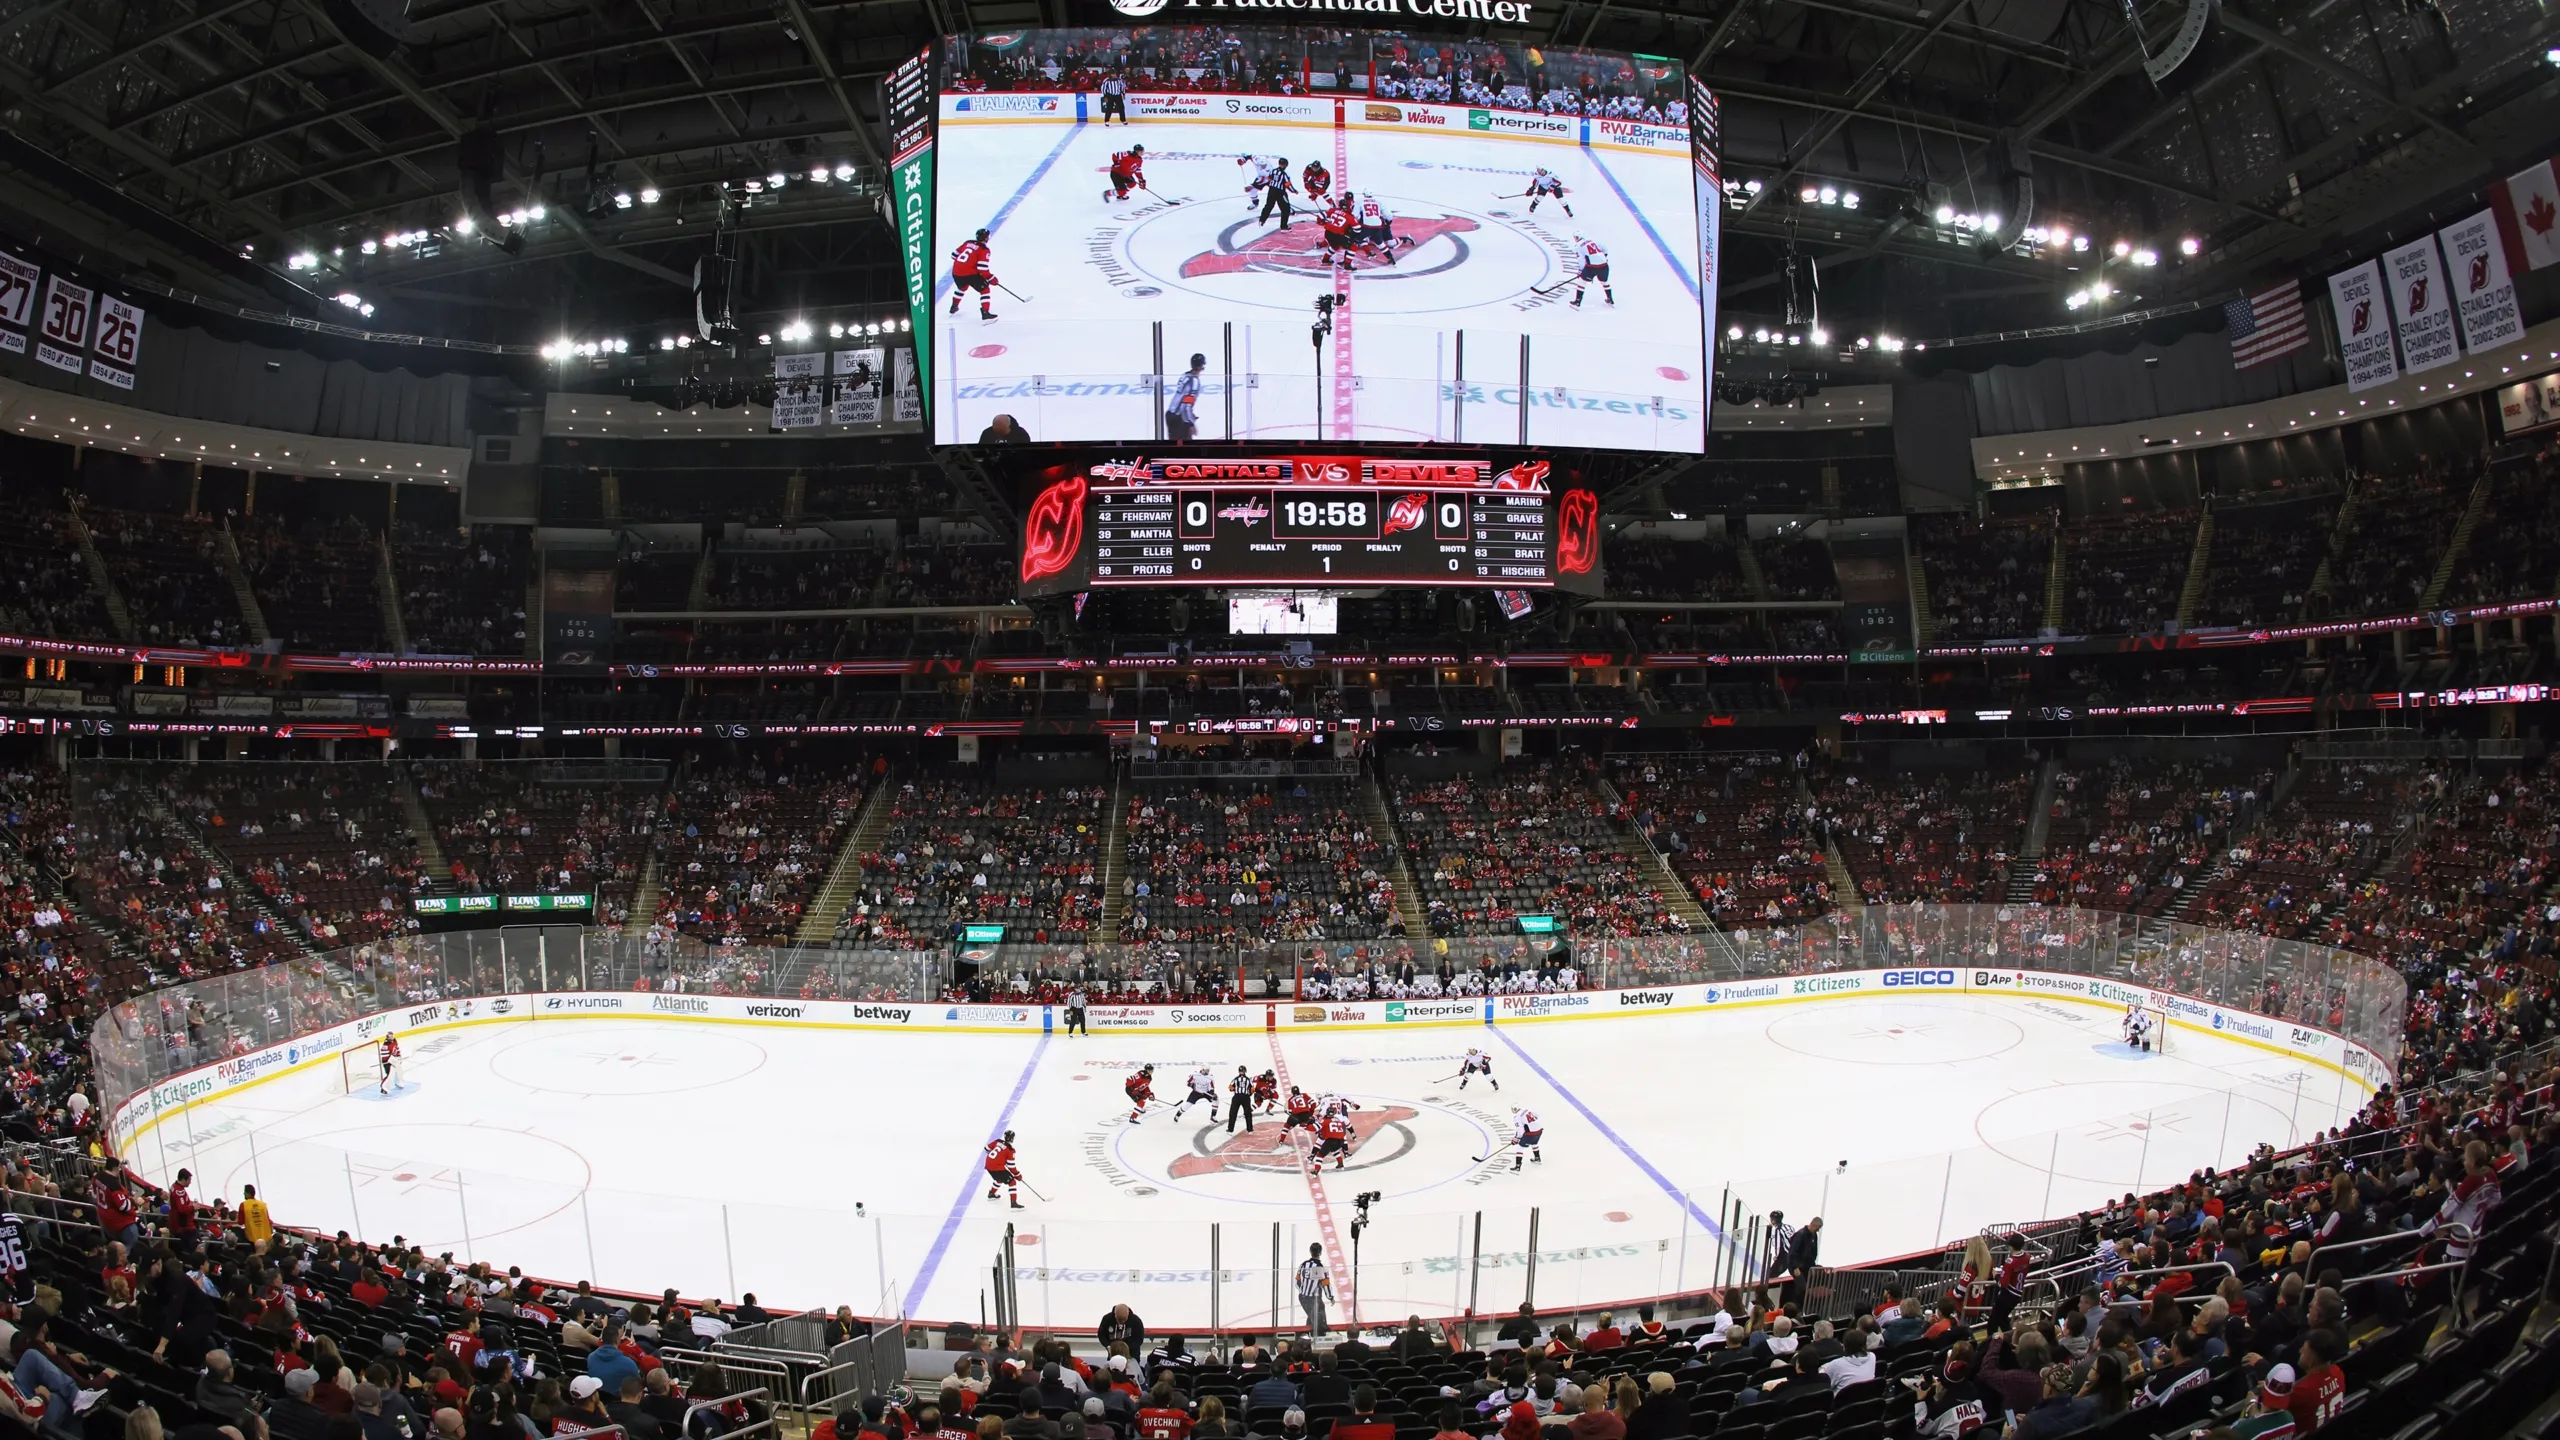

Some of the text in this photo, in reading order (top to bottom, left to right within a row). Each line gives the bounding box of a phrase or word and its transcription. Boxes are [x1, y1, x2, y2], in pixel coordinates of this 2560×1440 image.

[970, 96, 1041, 111] HALMAR
[1474, 116, 1568, 133] enterprise
[1600, 121, 1691, 143] RWJBarnaba
[1613, 135, 1654, 147] HEALTH
[1364, 203, 1379, 217] 59
[907, 192, 924, 307] Citizens
[2457, 235, 2488, 256] DEVILS
[957, 249, 973, 263] 6
[2399, 260, 2428, 279] DEVILS
[0, 273, 31, 321] 27
[56, 281, 86, 302] BRODEUR
[2343, 284, 2370, 302] DEVILS
[2461, 285, 2512, 316] STANLEY CUP
[47, 293, 86, 344] 30
[113, 304, 132, 320] ELIAS
[2466, 303, 2515, 332] CHAMPIONS
[2400, 310, 2449, 337] STANLEY CUP
[99, 313, 137, 361] 26
[2405, 327, 2451, 353] CHAMPIONS
[2472, 321, 2517, 346] 2002-2003
[6, 335, 24, 349] 2004
[2343, 331, 2390, 358] STANLEY CUP
[40, 347, 80, 368] 1990 2014
[2348, 348, 2391, 372] CHAMPIONS
[2410, 344, 2453, 366] 1999-2000
[93, 364, 132, 386] 1994 2016
[786, 364, 812, 373] DEVILS
[2352, 364, 2392, 385] 1994-1995
[838, 402, 874, 413] CHAMPIONS
[780, 417, 814, 425] 1987-1988
[838, 413, 874, 421] 1994-1995
[1165, 463, 1477, 482] CAPITALS VS DEVILS
[1104, 494, 1172, 503] 3 JENSEN
[1478, 496, 1543, 506] 6 MARINO
[1098, 512, 1172, 521] 42 FEHERVARY
[1186, 501, 1207, 527] 0
[1285, 502, 1366, 526] 19:58
[1441, 503, 1461, 528] 0
[1473, 513, 1543, 524] 33 GRAVES
[1098, 529, 1173, 539] 39 MANTHA
[1476, 531, 1544, 541] 18 PALAT
[1098, 547, 1173, 557] 20 ELLER
[1183, 544, 1211, 552] SHOTS
[1250, 543, 1286, 551] PENALTY
[1312, 544, 1342, 552] PERIOD
[1366, 544, 1401, 552] PENALTY
[1440, 545, 1466, 553] SHOTS
[1474, 548, 1545, 559] 63 BRATT
[1132, 565, 1173, 575] PROTAS
[1191, 557, 1202, 570] 0
[1322, 557, 1330, 573] 1
[1448, 558, 1459, 571] 0
[1477, 566, 1545, 577] 13 HISCHIER
[1860, 617, 1894, 625] 1982
[2428, 601, 2554, 627] VS NEW JERSEY
[560, 629, 595, 638] 1982
[2271, 616, 2419, 638] WASHINGTON CAPITALS
[1869, 653, 1905, 661] Citizens
[1925, 646, 2030, 656] JERSEY DEVILS
[376, 661, 473, 671] WASHINGTON
[627, 664, 817, 677] VS NEW JERSEY DEVILS
[2089, 707, 2120, 716] NEW
[2123, 706, 2174, 714] JERSEY
[2178, 703, 2225, 712] DEVILS
[163, 725, 213, 733] JERSEY
[218, 725, 269, 733] DEVILS
[863, 725, 917, 733] DEVILS
[1808, 976, 1861, 993] Citizens
[1883, 970, 1954, 987] GEICO
[2024, 977, 2085, 991] STOP&SHOP
[1620, 991, 1674, 1007] betway
[1723, 984, 1779, 1000] Prudential
[2102, 984, 2144, 1005] Citizens
[492, 1000, 511, 1011] NHL
[568, 998, 622, 1008] HYUNDAI
[652, 995, 708, 1011] Atlantic
[1503, 995, 1589, 1009] RWJBarnabas
[2150, 992, 2208, 1018] RWJBarnabas
[747, 1004, 800, 1018] verizon
[854, 1005, 911, 1023] betway
[958, 1007, 1013, 1021] HALMAR
[1331, 1008, 1365, 1021] Wawa
[1392, 1004, 1474, 1018] enterprise
[1514, 1007, 1550, 1017] HEALTH
[2226, 1016, 2273, 1040] Prudential
[302, 1033, 343, 1058] Prudential
[218, 1051, 283, 1080] RWJBarnabas
[229, 1071, 256, 1086] HEALTH
[163, 1076, 212, 1106] Citizens
[1292, 1096, 1306, 1108] 13
[1329, 1122, 1343, 1133] 63
[989, 1146, 1001, 1159] 6
[2319, 1378, 2340, 1400] ZAJAC
[1957, 1402, 1981, 1420] HALL
[1144, 1417, 1181, 1428] OVECHKIN
